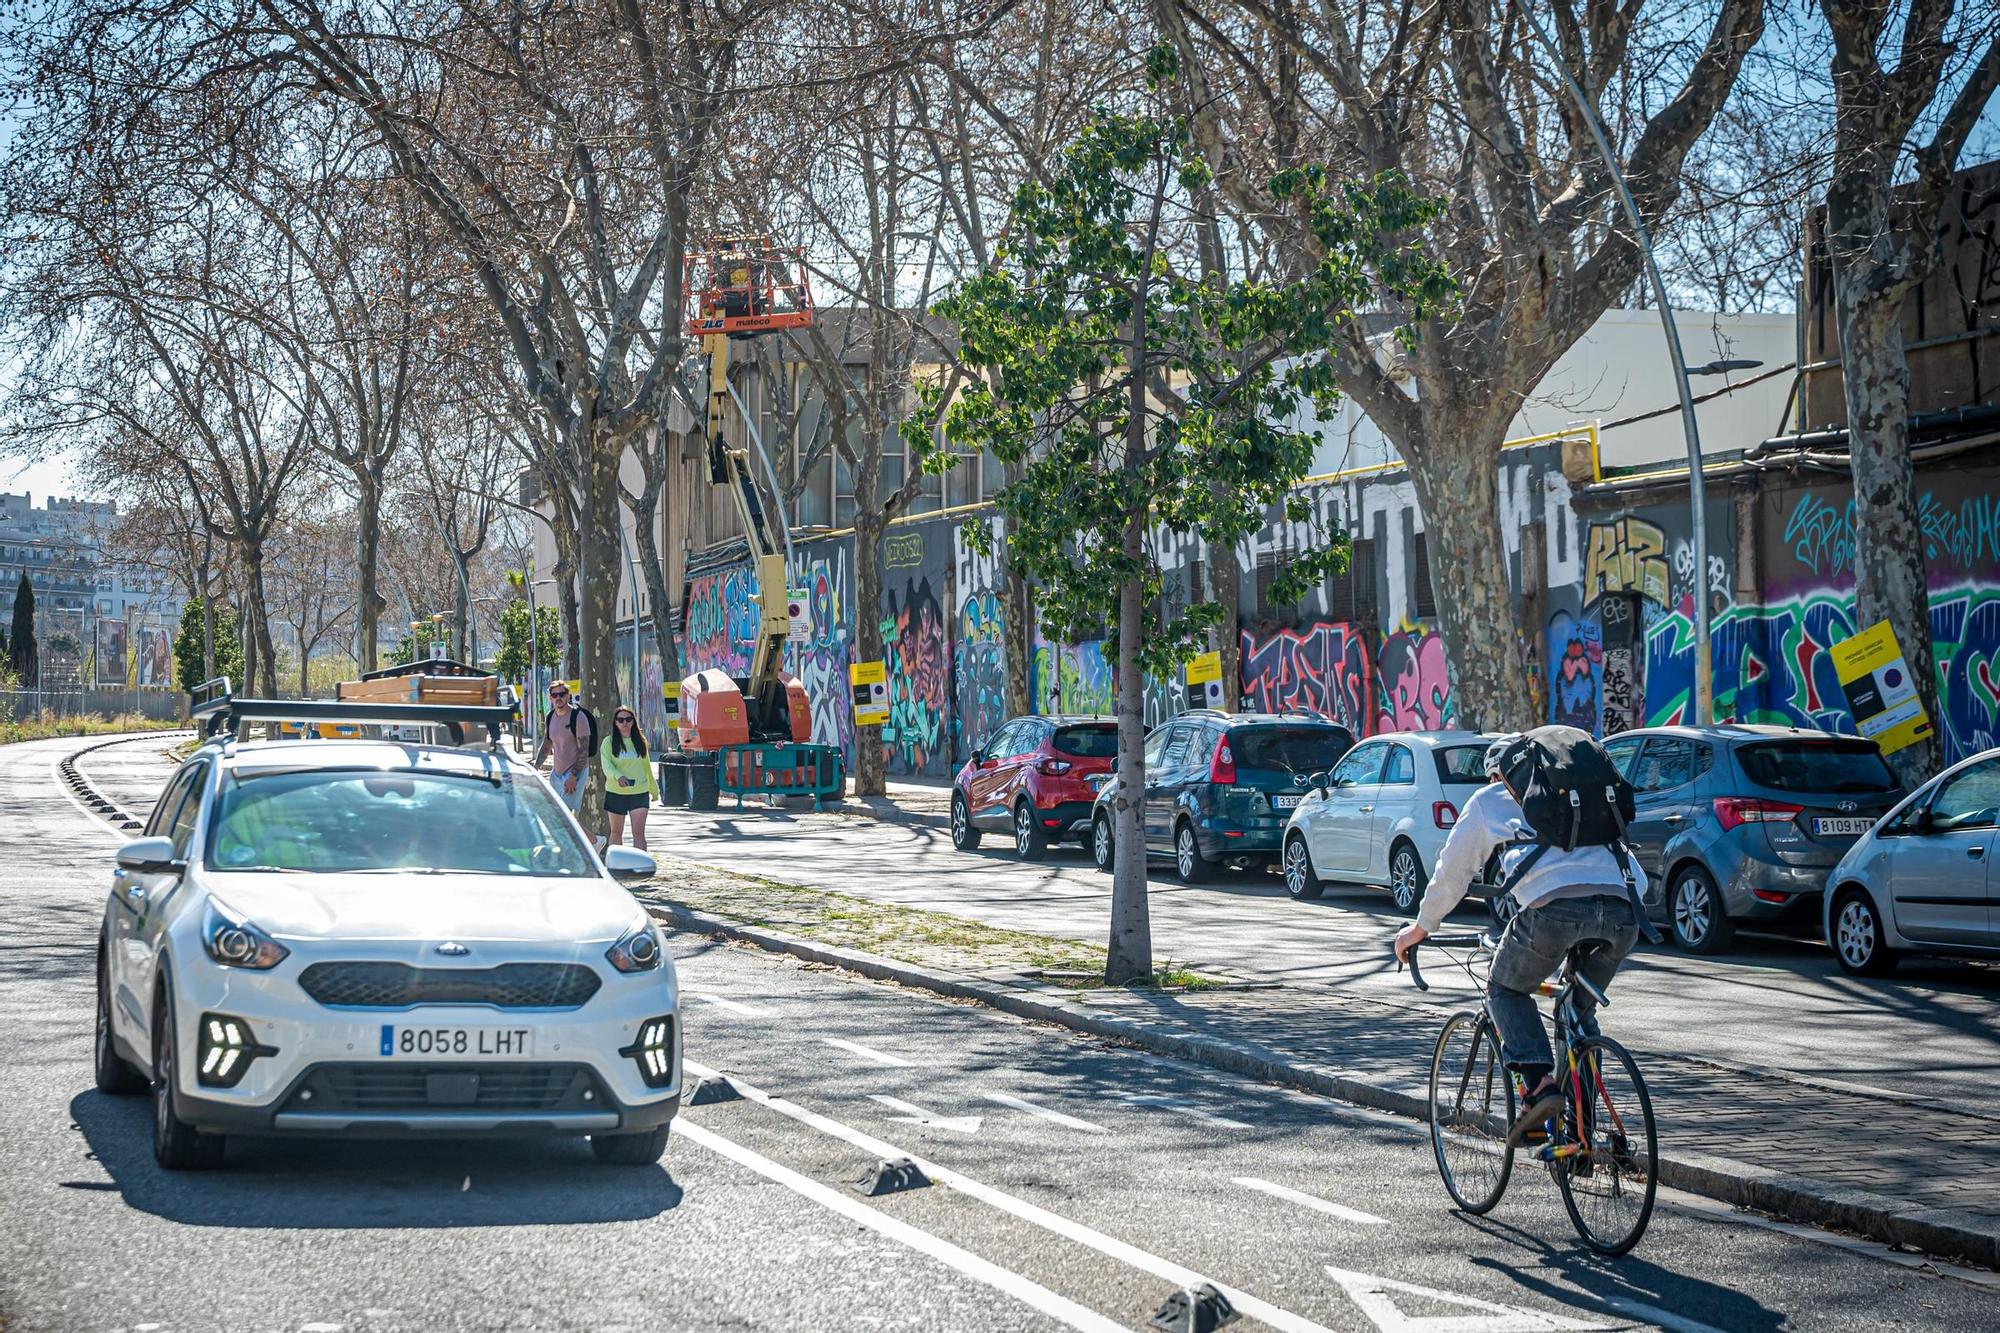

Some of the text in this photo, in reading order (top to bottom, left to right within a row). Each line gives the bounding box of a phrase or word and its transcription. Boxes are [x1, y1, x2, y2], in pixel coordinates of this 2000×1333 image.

[702, 318, 770, 329] JLG mateco
[1822, 820, 1850, 832] 8109
[400, 1029, 529, 1054] 8058 LHT
